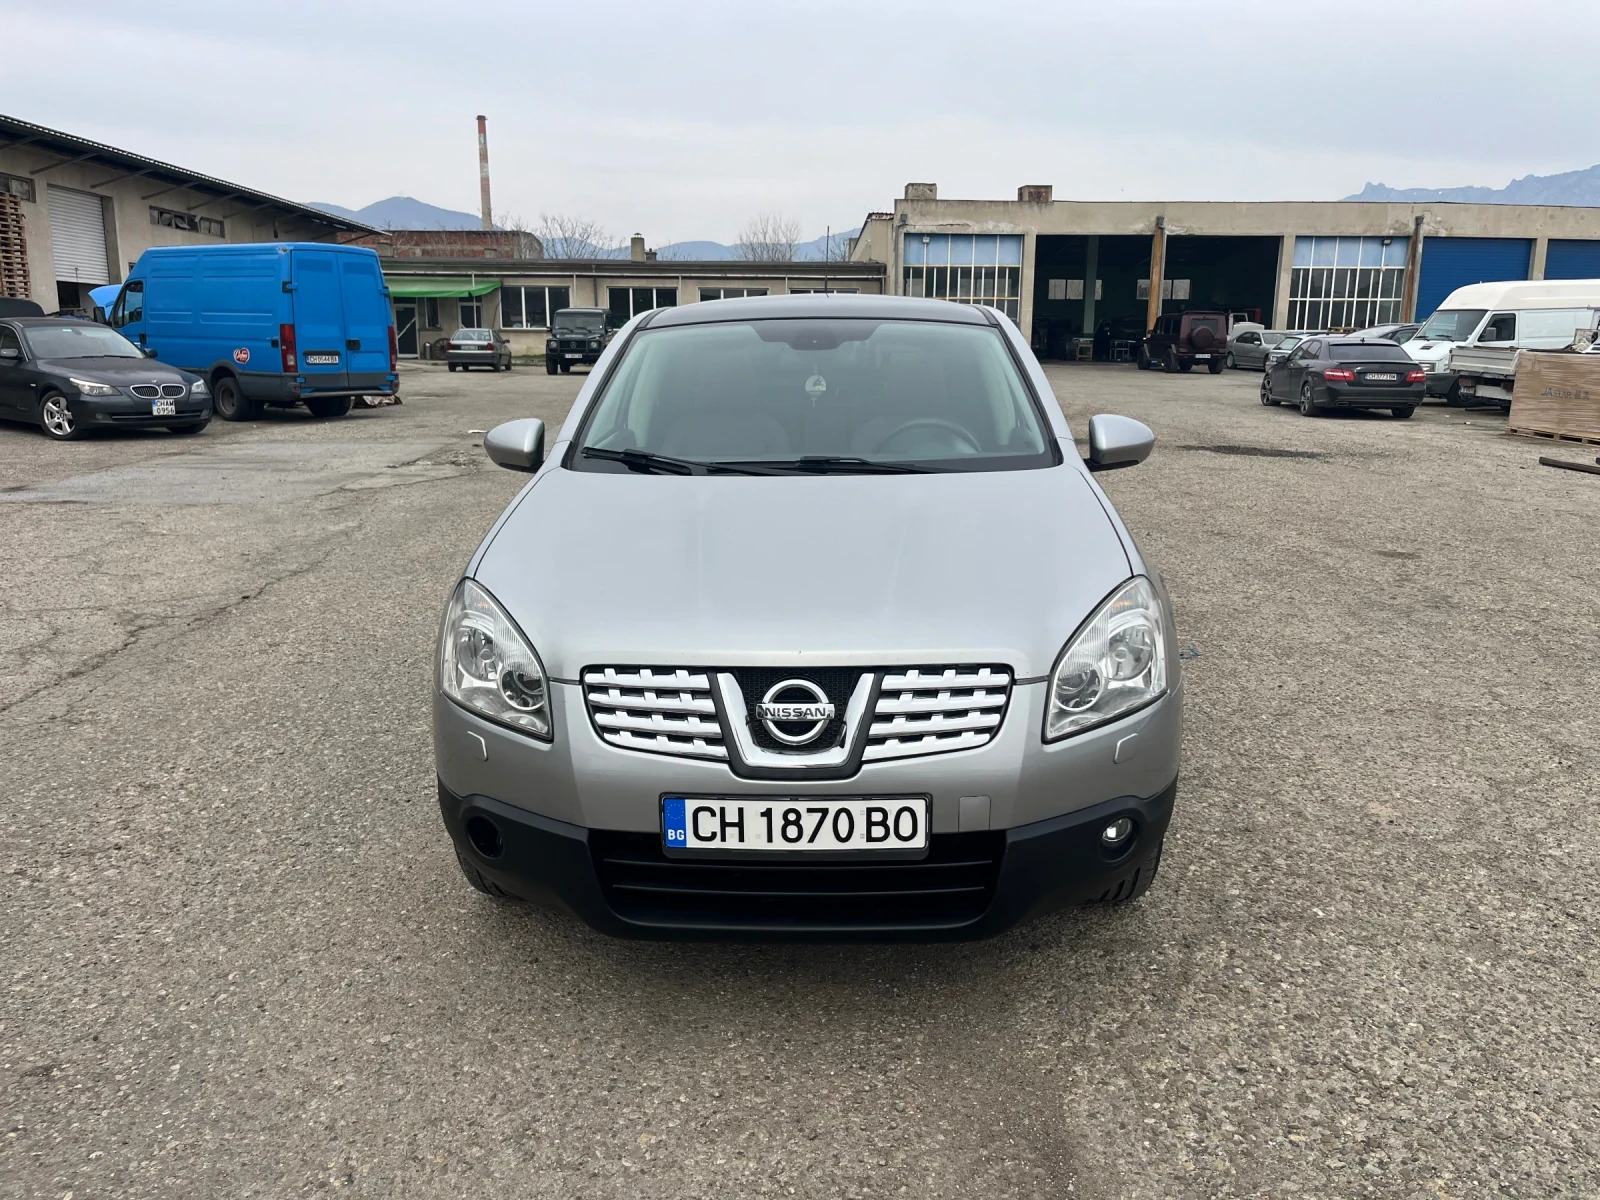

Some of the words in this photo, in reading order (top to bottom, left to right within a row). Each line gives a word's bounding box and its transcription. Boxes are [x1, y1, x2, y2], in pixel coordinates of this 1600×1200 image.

[765, 707, 826, 718] NISSAN
[692, 806, 745, 842] CH
[760, 807, 855, 843] 1870
[865, 806, 918, 842] BO
[667, 829, 685, 841] BG
